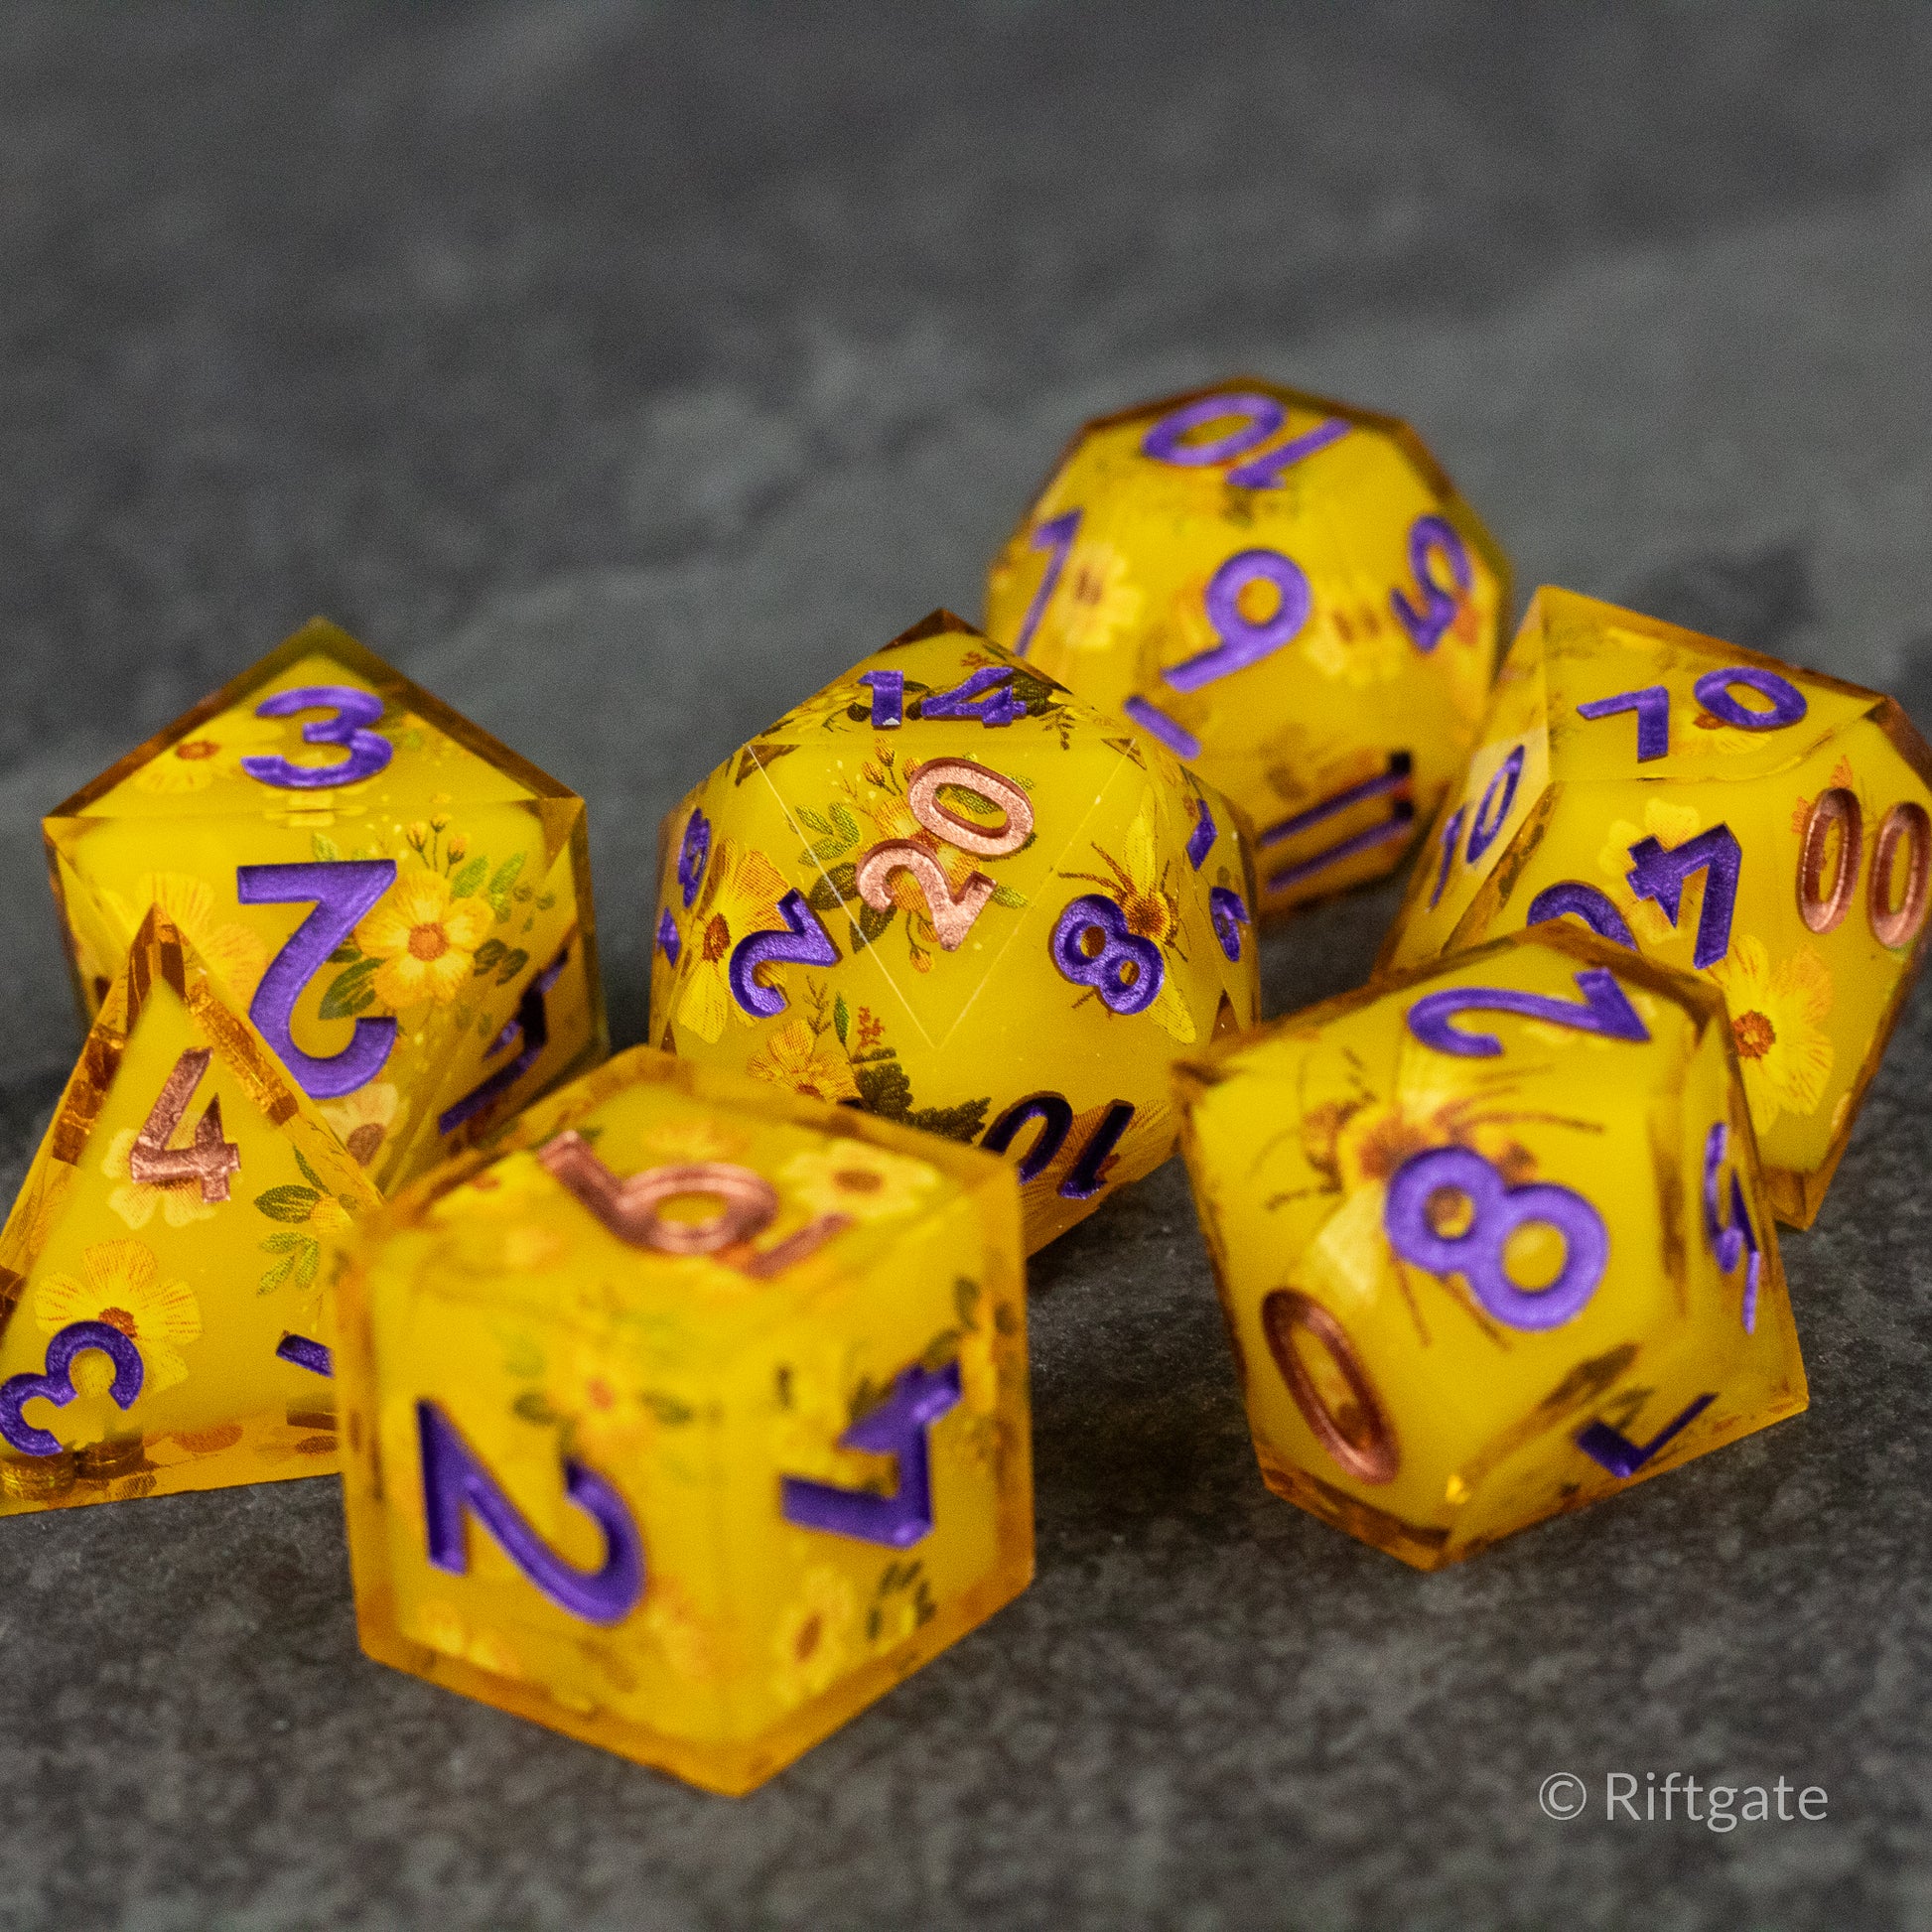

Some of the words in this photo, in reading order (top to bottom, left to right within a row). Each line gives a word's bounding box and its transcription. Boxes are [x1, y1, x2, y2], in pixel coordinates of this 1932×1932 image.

[241, 686, 393, 788] 3
[857, 666, 1028, 728] 14
[1577, 665, 1807, 763] 70
[855, 757, 1035, 953] 20
[1798, 787, 1932, 948] 00
[236, 859, 396, 1099] 2
[729, 887, 842, 1019] 2
[1048, 894, 1165, 1016] 8
[1407, 966, 1652, 1058] 2
[130, 1047, 241, 1203] 4
[1383, 1146, 1611, 1332] 8
[0, 1320, 144, 1456] 3
[1263, 1290, 1400, 1486] 0
[416, 1398, 648, 1628] 2
